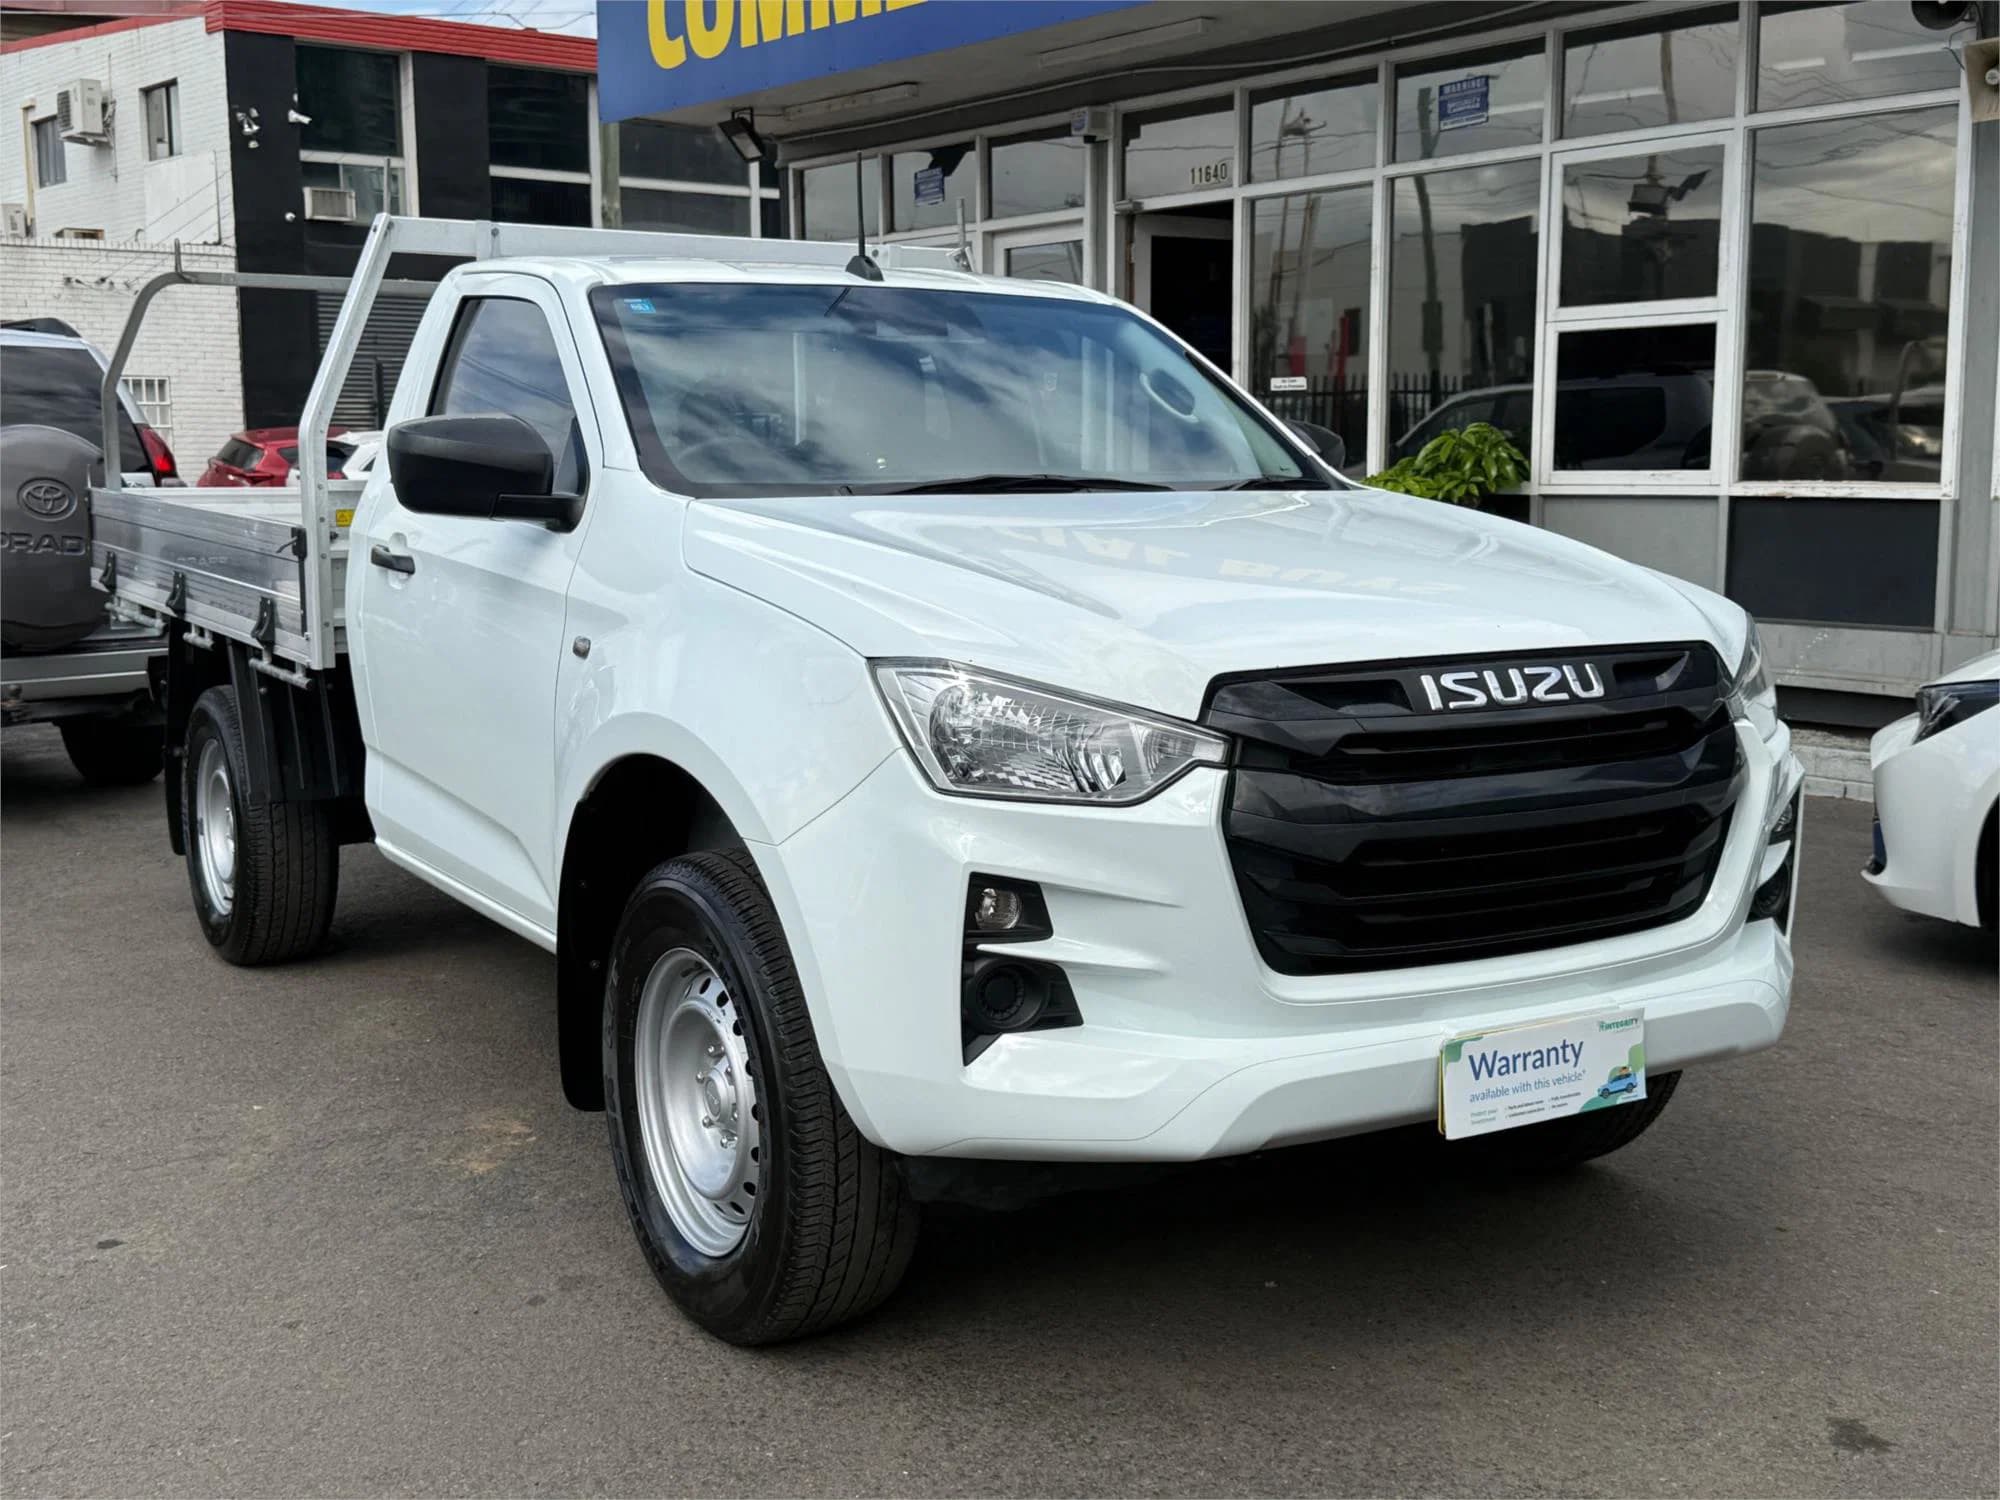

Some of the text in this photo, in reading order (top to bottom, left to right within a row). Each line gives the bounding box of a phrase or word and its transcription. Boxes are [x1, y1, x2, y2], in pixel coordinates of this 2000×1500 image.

[648, 0, 928, 69] COM
[1420, 663, 1605, 711] ISUZU
[1468, 1039, 1584, 1081] Warranty
[1470, 1085, 1509, 1103] available
[1512, 1080, 1532, 1095] with
[1534, 1077, 1550, 1090] this
